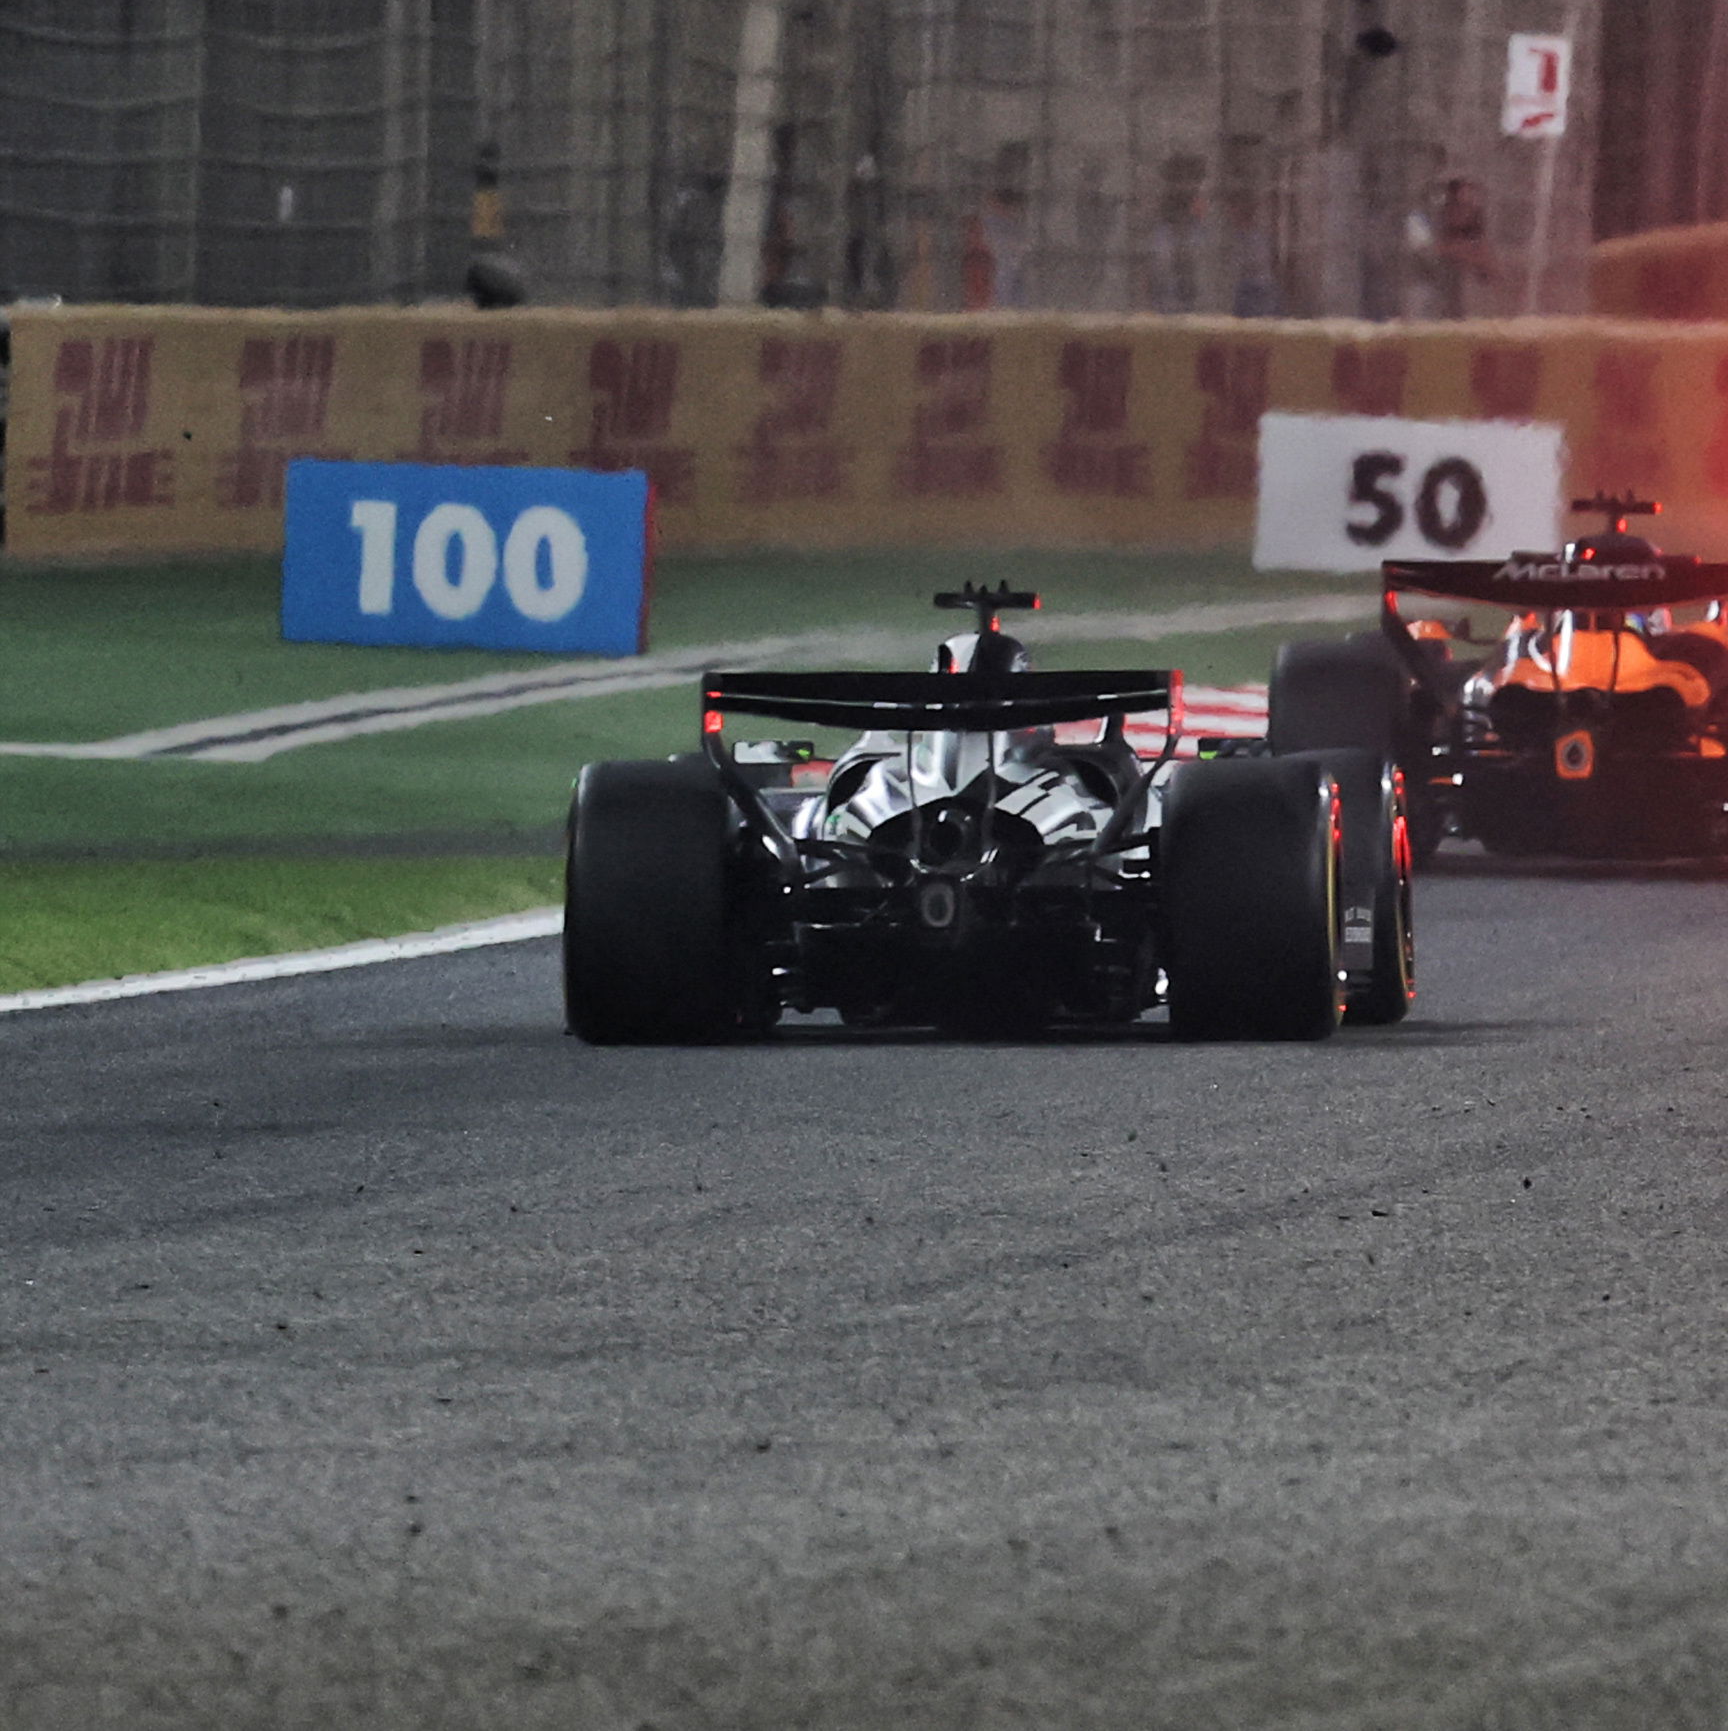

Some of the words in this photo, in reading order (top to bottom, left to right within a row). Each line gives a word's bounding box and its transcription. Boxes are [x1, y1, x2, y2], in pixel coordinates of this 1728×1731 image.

[1346, 450, 1487, 550] 50
[351, 500, 588, 622] 100
[1493, 561, 1666, 581] McLaren
